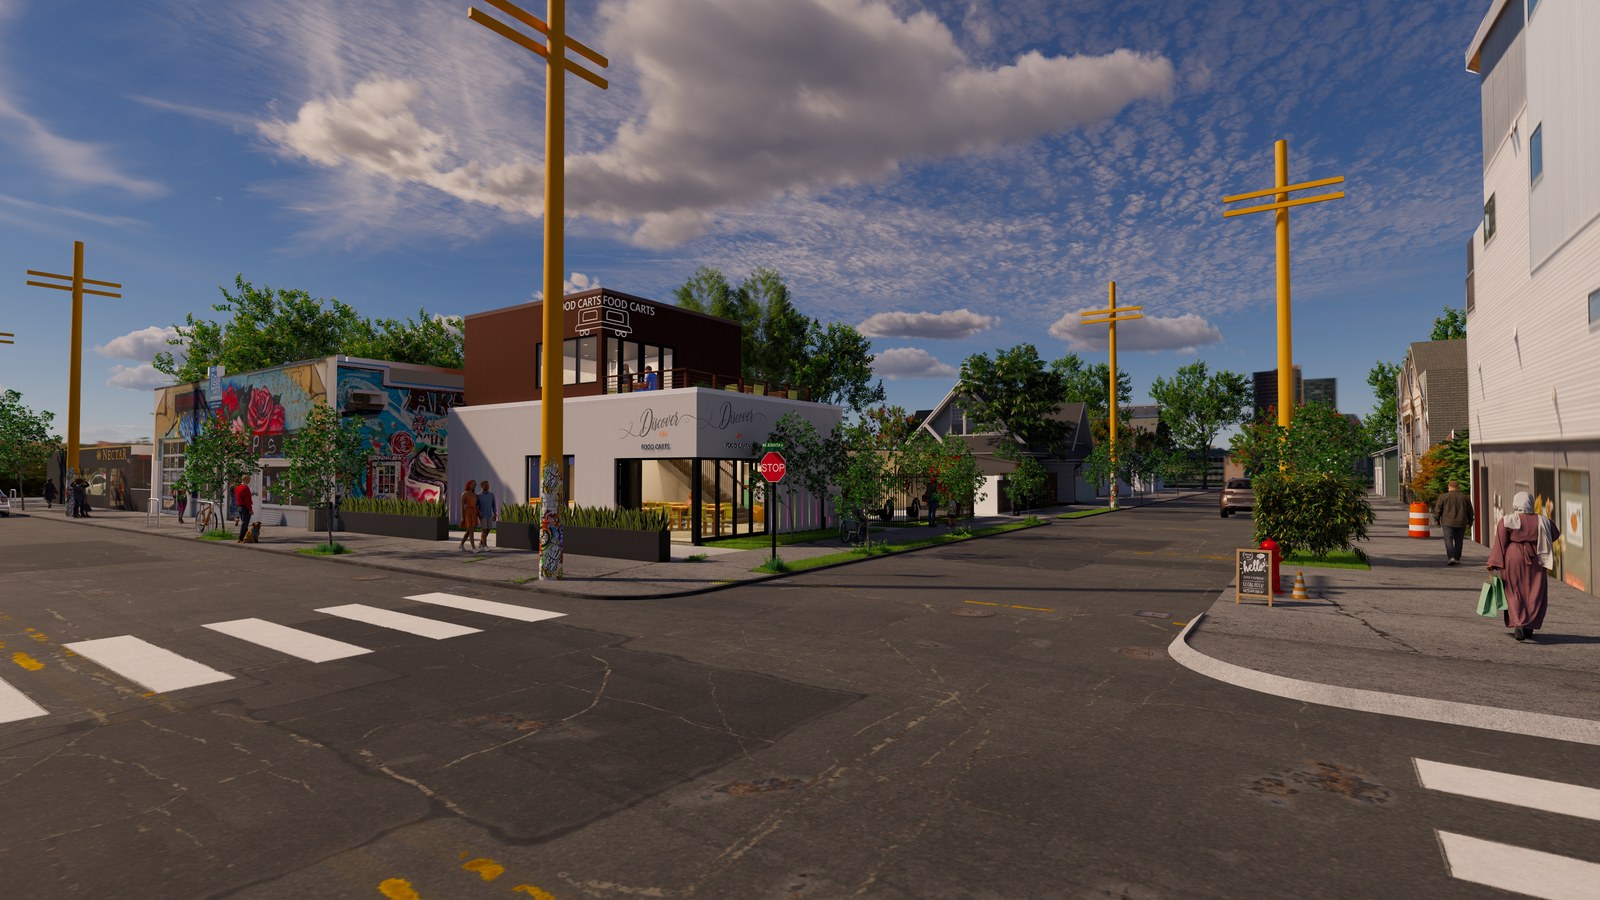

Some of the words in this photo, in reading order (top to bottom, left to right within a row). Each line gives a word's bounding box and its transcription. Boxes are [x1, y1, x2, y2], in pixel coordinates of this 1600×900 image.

[563, 301, 576, 311] OD
[577, 295, 602, 308] CARTS
[603, 295, 628, 309] FOOD
[629, 302, 655, 316] CARTS
[637, 408, 682, 438] Discover
[717, 401, 756, 430] Discover
[761, 463, 785, 473] STOP
[1243, 559, 1266, 573] hello
